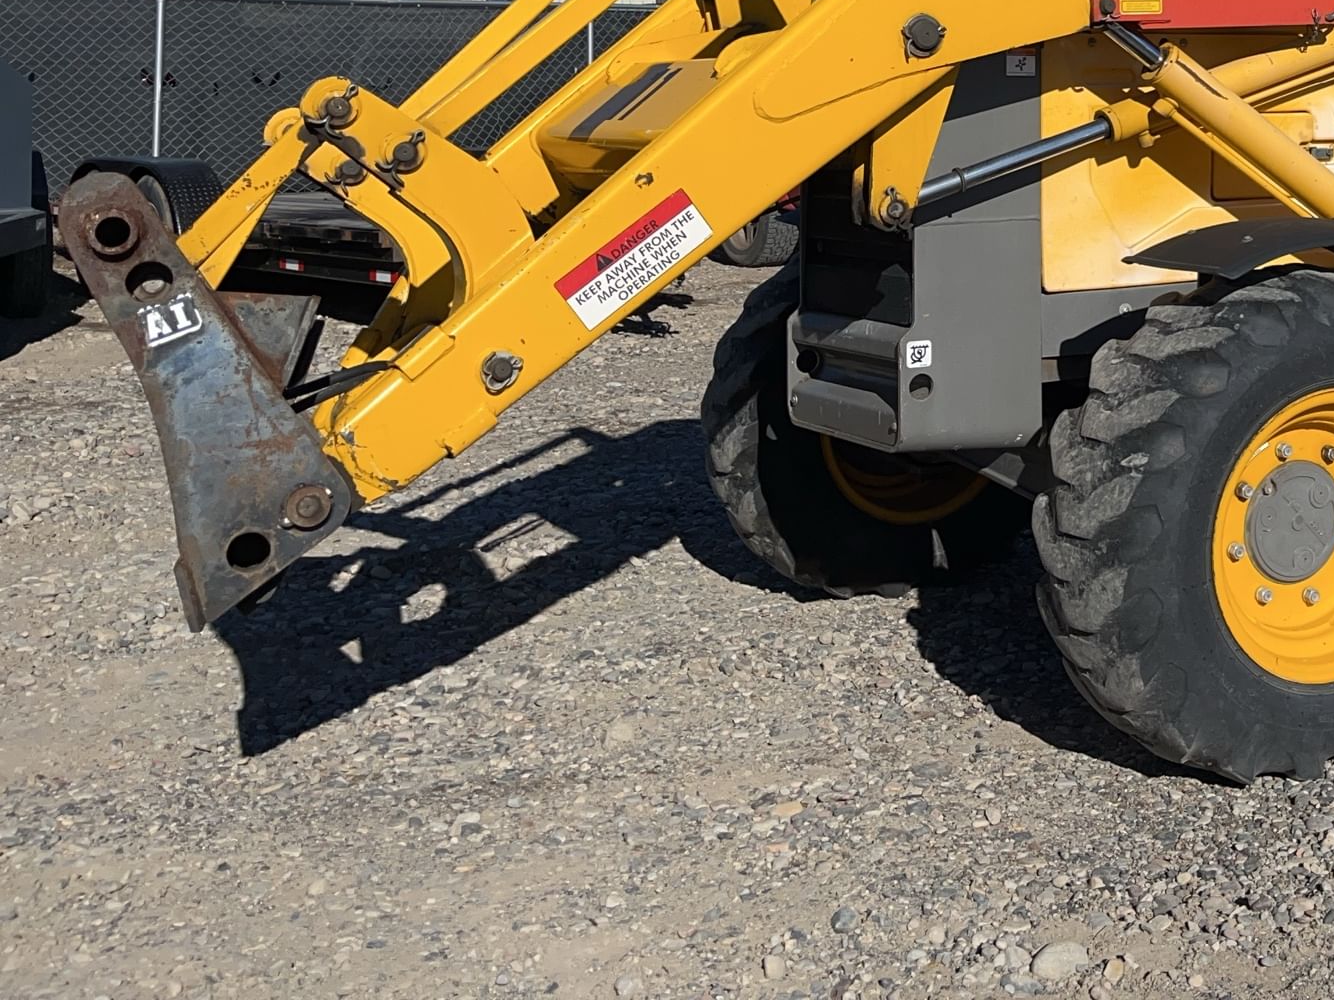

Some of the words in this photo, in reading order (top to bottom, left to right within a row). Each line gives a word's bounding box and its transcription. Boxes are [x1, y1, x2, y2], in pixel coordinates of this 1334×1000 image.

[575, 280, 602, 306] KEEP
[605, 253, 637, 284] AWAY
[638, 228, 672, 257] FROM
[671, 210, 695, 231] THE
[597, 258, 651, 304] MACHINE
[651, 230, 687, 261] WHEN
[610, 219, 659, 260] DANGER
[618, 250, 680, 302] OPERATING
